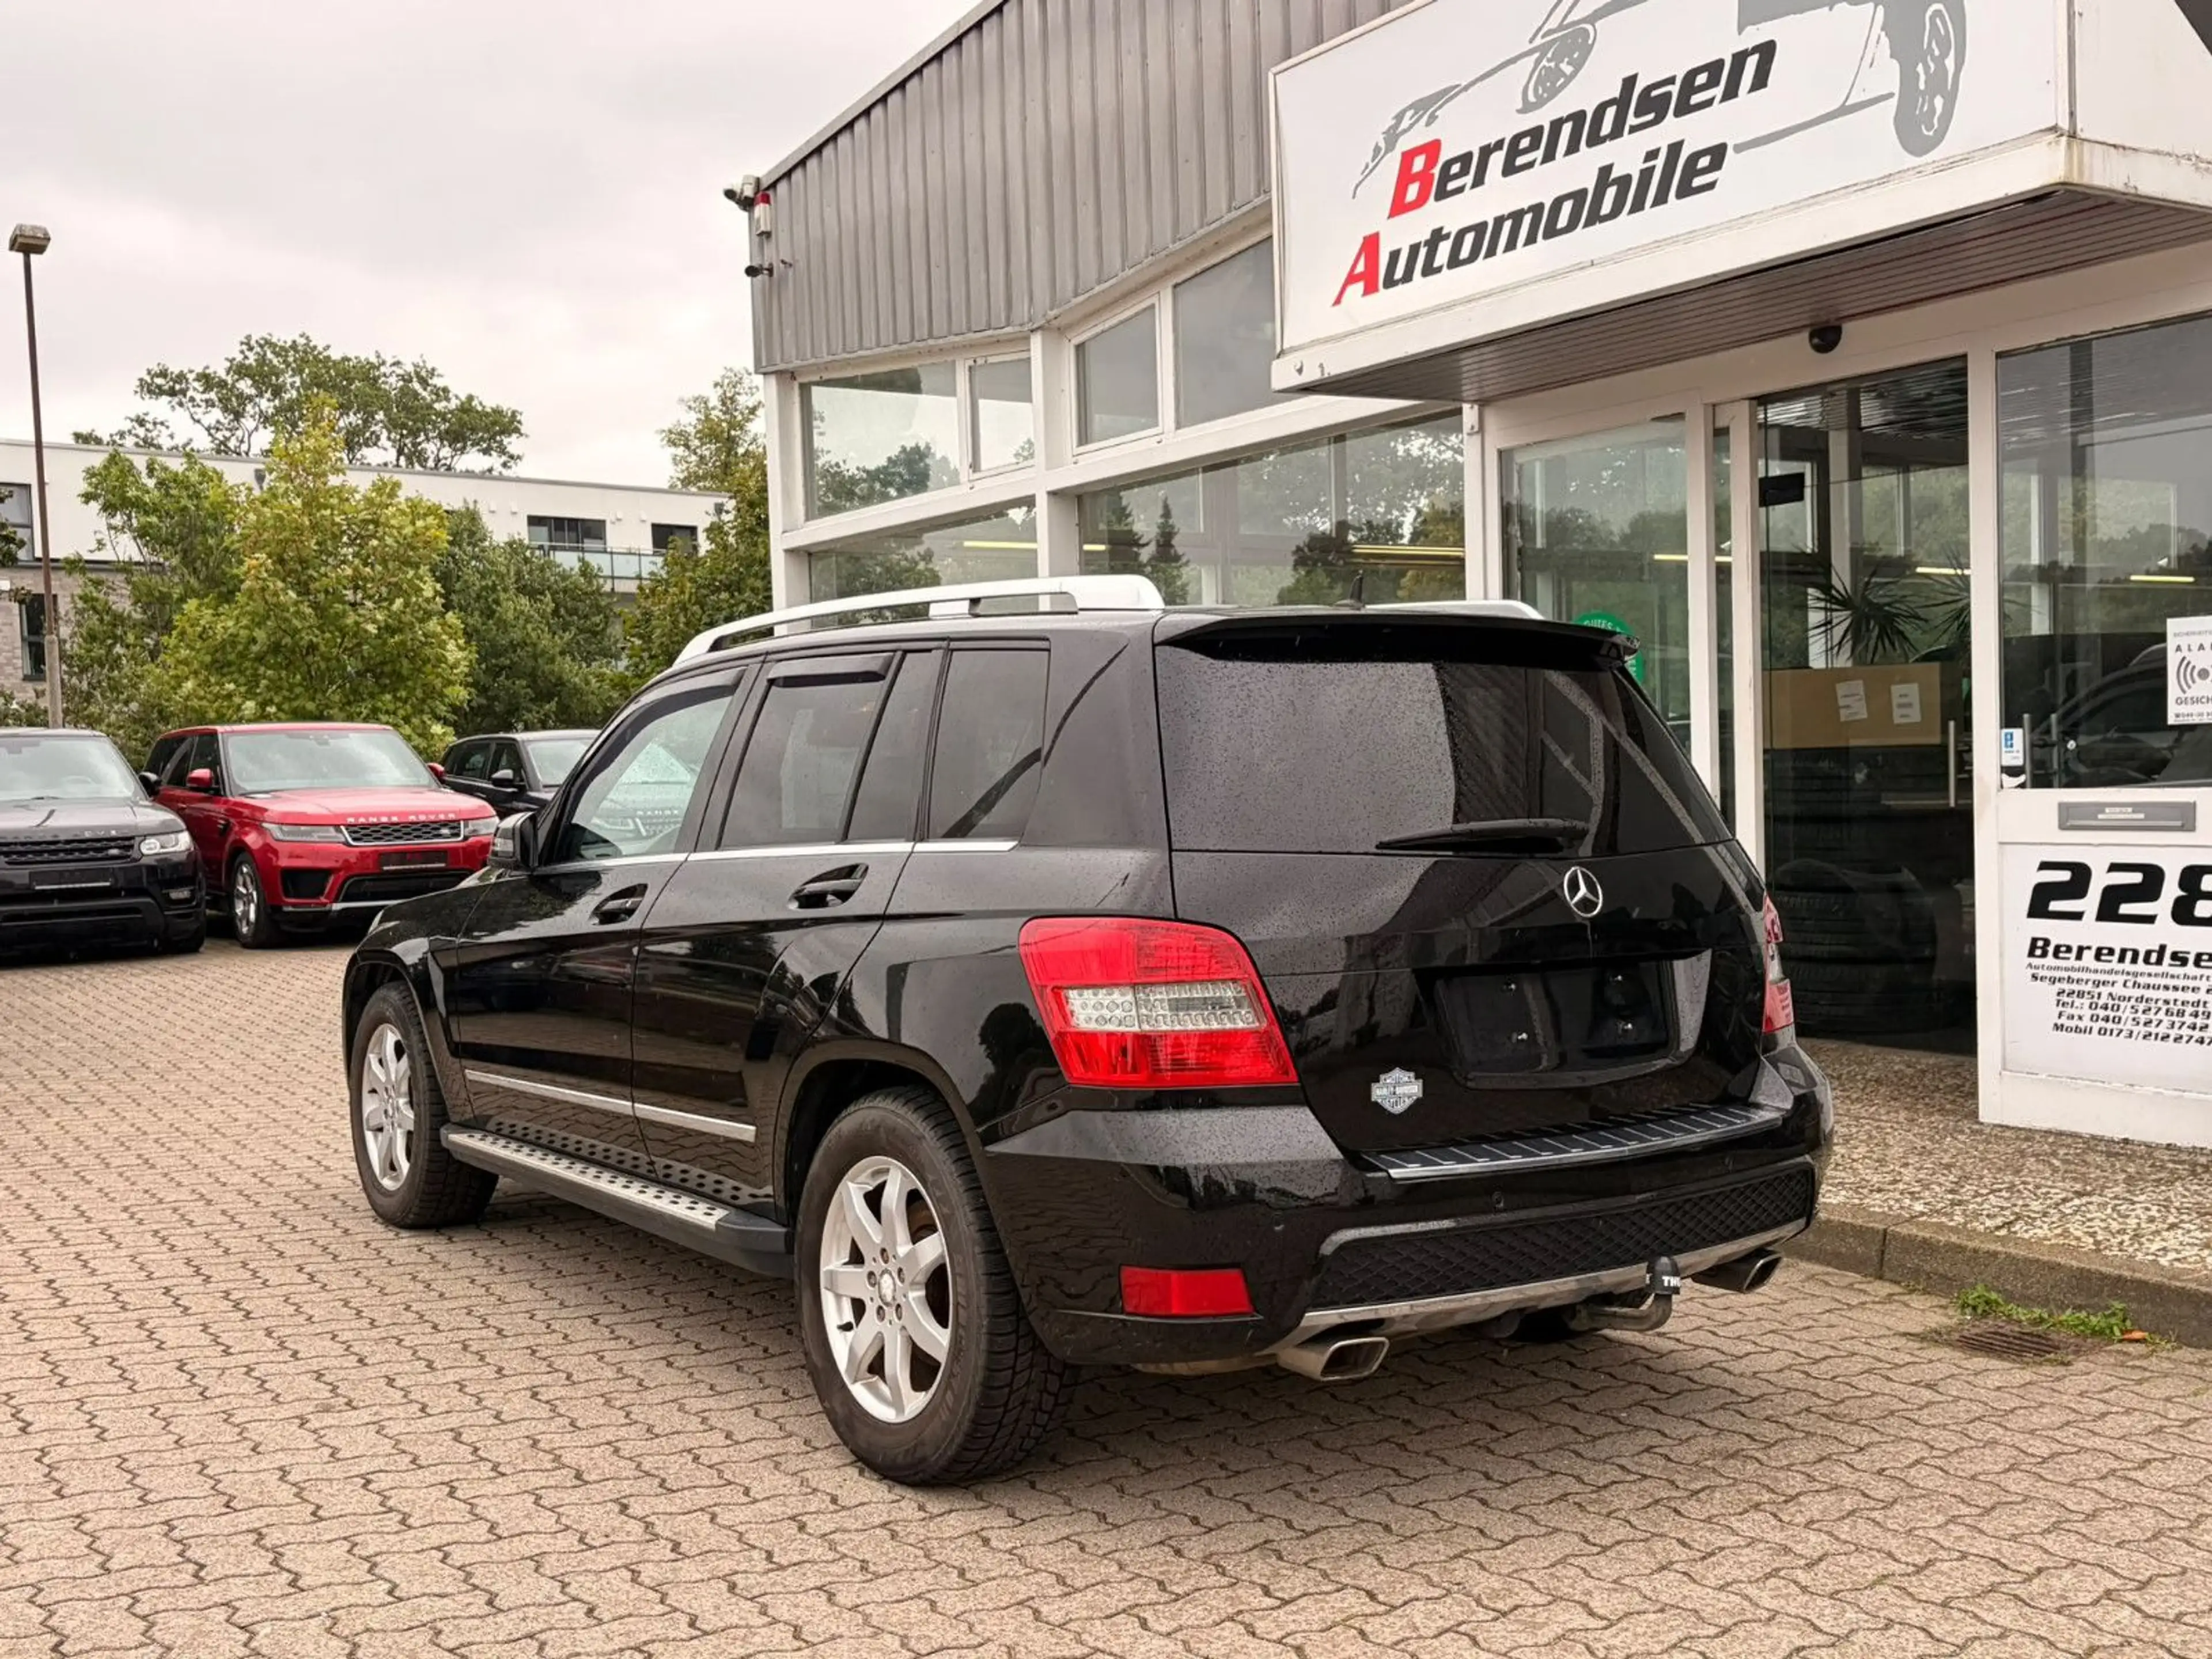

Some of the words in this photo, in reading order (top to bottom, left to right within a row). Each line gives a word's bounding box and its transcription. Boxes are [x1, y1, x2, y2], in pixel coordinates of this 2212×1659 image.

[1388, 38, 1778, 219] Berendsen
[1332, 139, 1727, 306] Automobile
[2175, 642, 2212, 653] ALA
[2025, 963, 2211, 982] Automobilhandelsgesellschaft
[2031, 972, 2118, 989] Segeberger
[2122, 979, 2201, 994] Chaussee
[2055, 999, 2084, 1009] Tel.:
[2056, 988, 2101, 1001] 22851
[2106, 991, 2209, 1008] Norderstedt
[2058, 1011, 2084, 1021] Fax
[2052, 1022, 2093, 1036] Mobil
